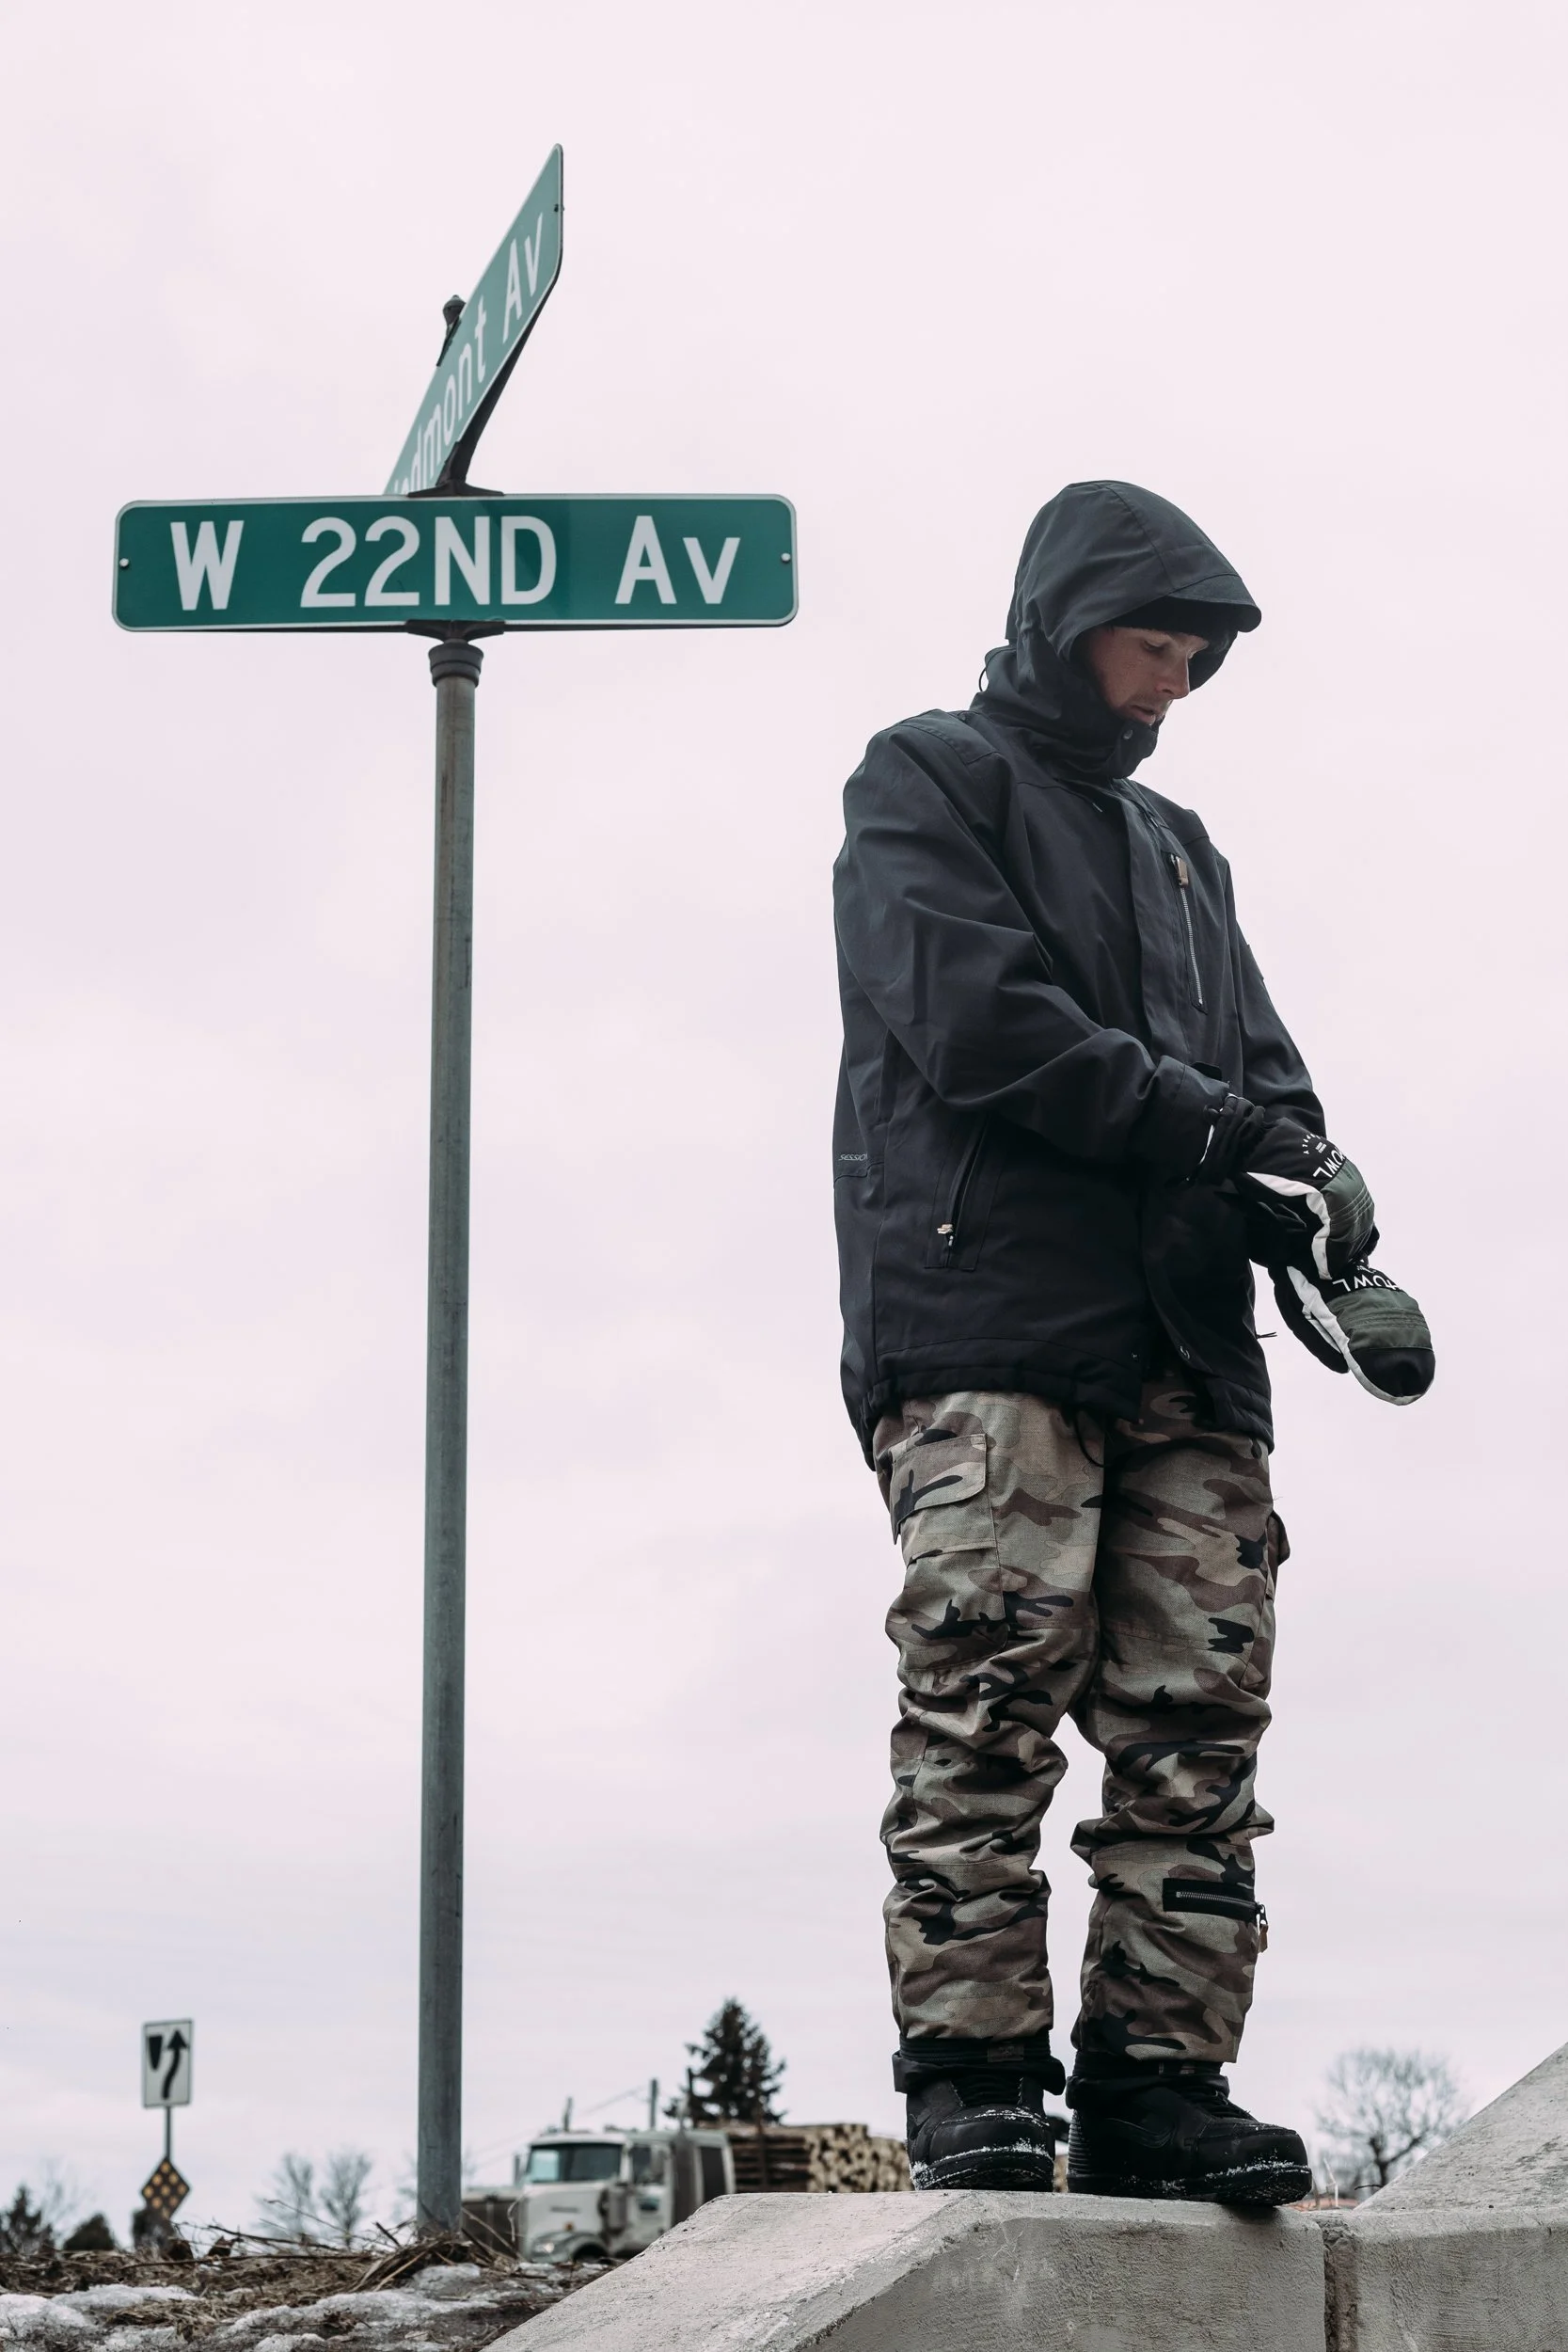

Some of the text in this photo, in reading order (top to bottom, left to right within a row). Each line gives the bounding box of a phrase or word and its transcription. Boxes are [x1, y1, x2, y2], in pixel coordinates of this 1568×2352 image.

[394, 213, 544, 493] dmont Av
[170, 515, 740, 611] W 22ND Av
